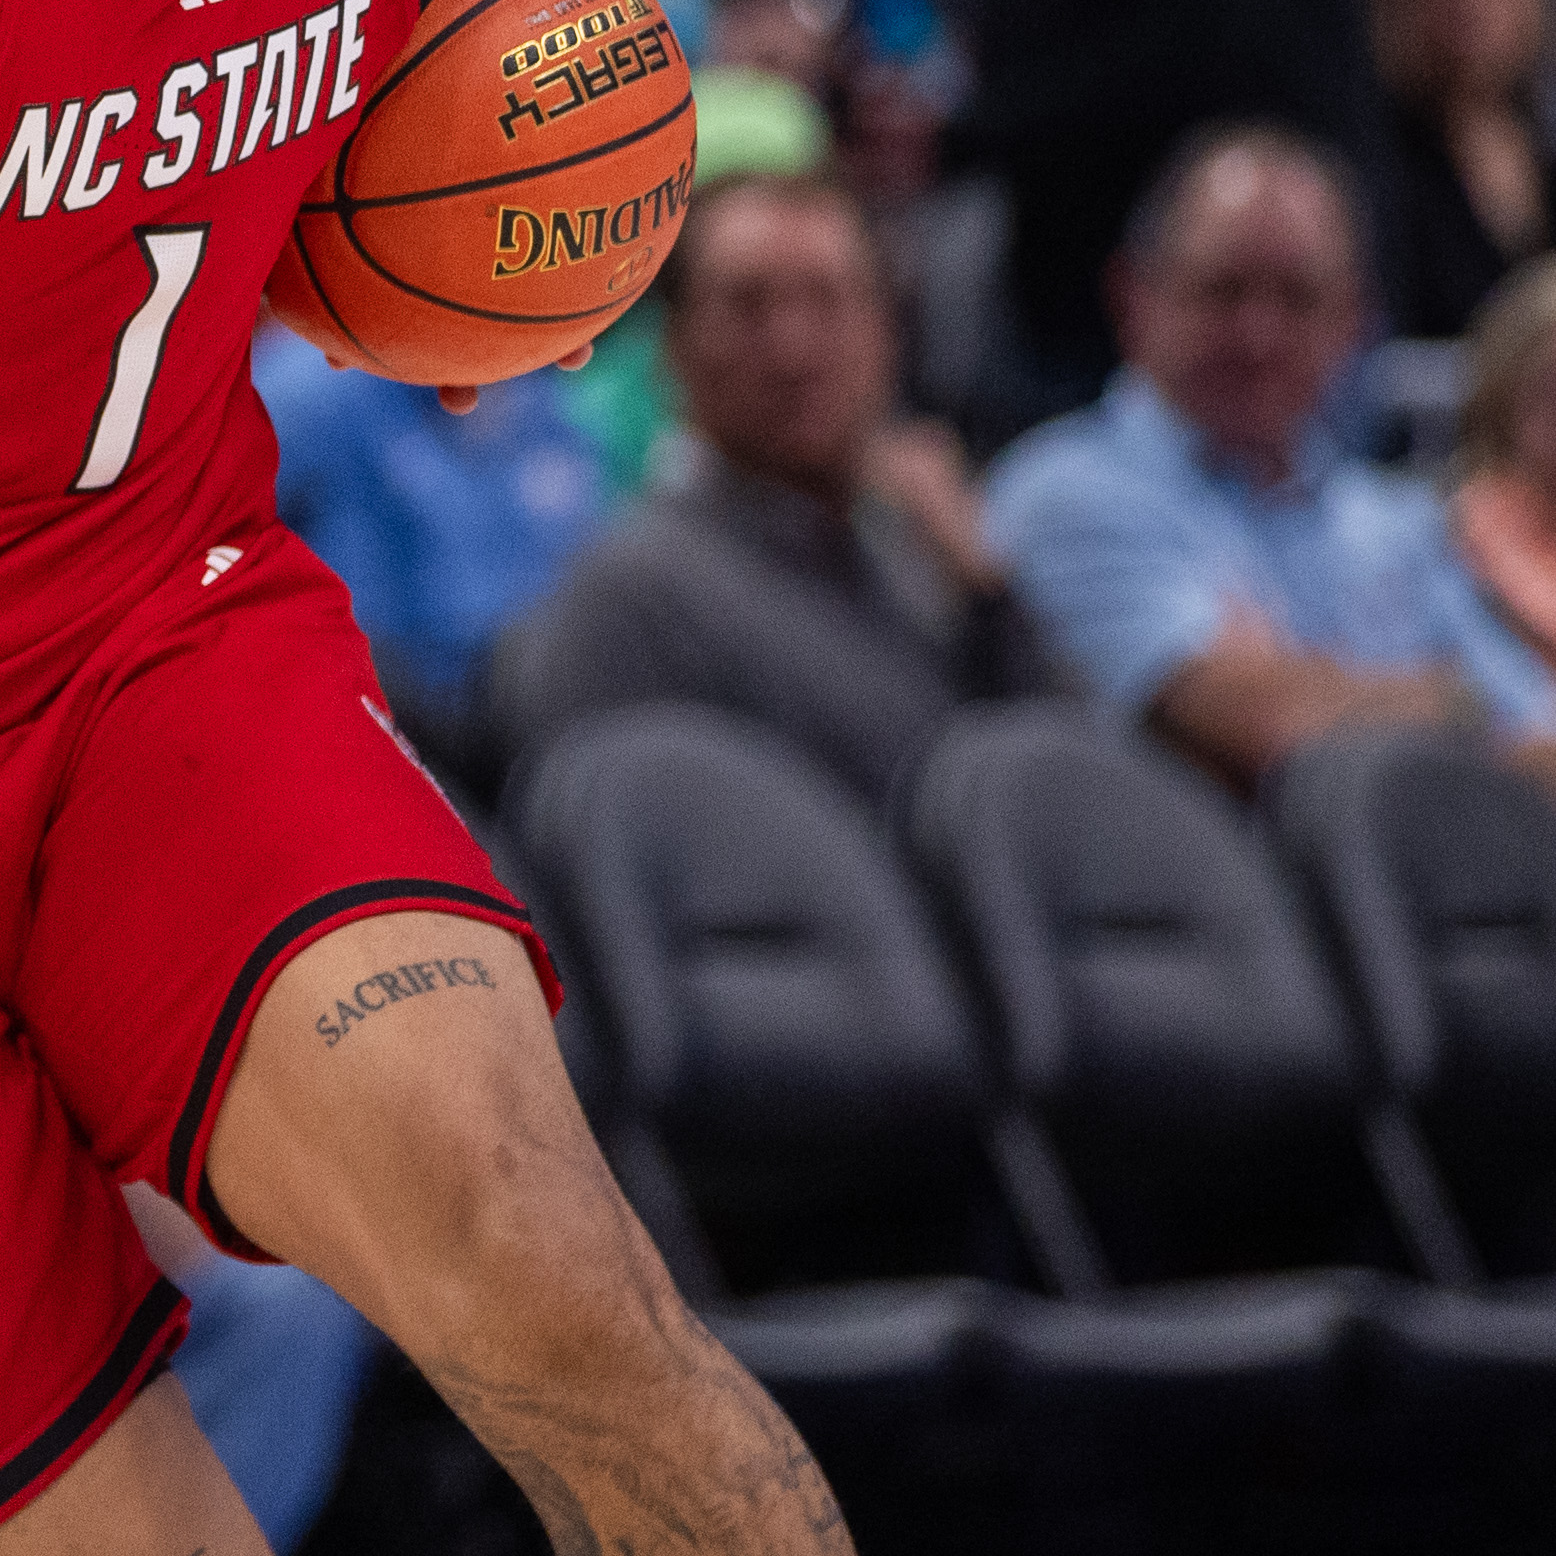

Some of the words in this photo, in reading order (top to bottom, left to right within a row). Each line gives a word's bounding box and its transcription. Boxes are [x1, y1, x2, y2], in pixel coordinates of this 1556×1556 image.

[497, 18, 683, 143] LEGACY
[491, 154, 696, 281] PALDING
[68, 222, 211, 496] 1
[315, 957, 496, 1049] SACRIFICE
